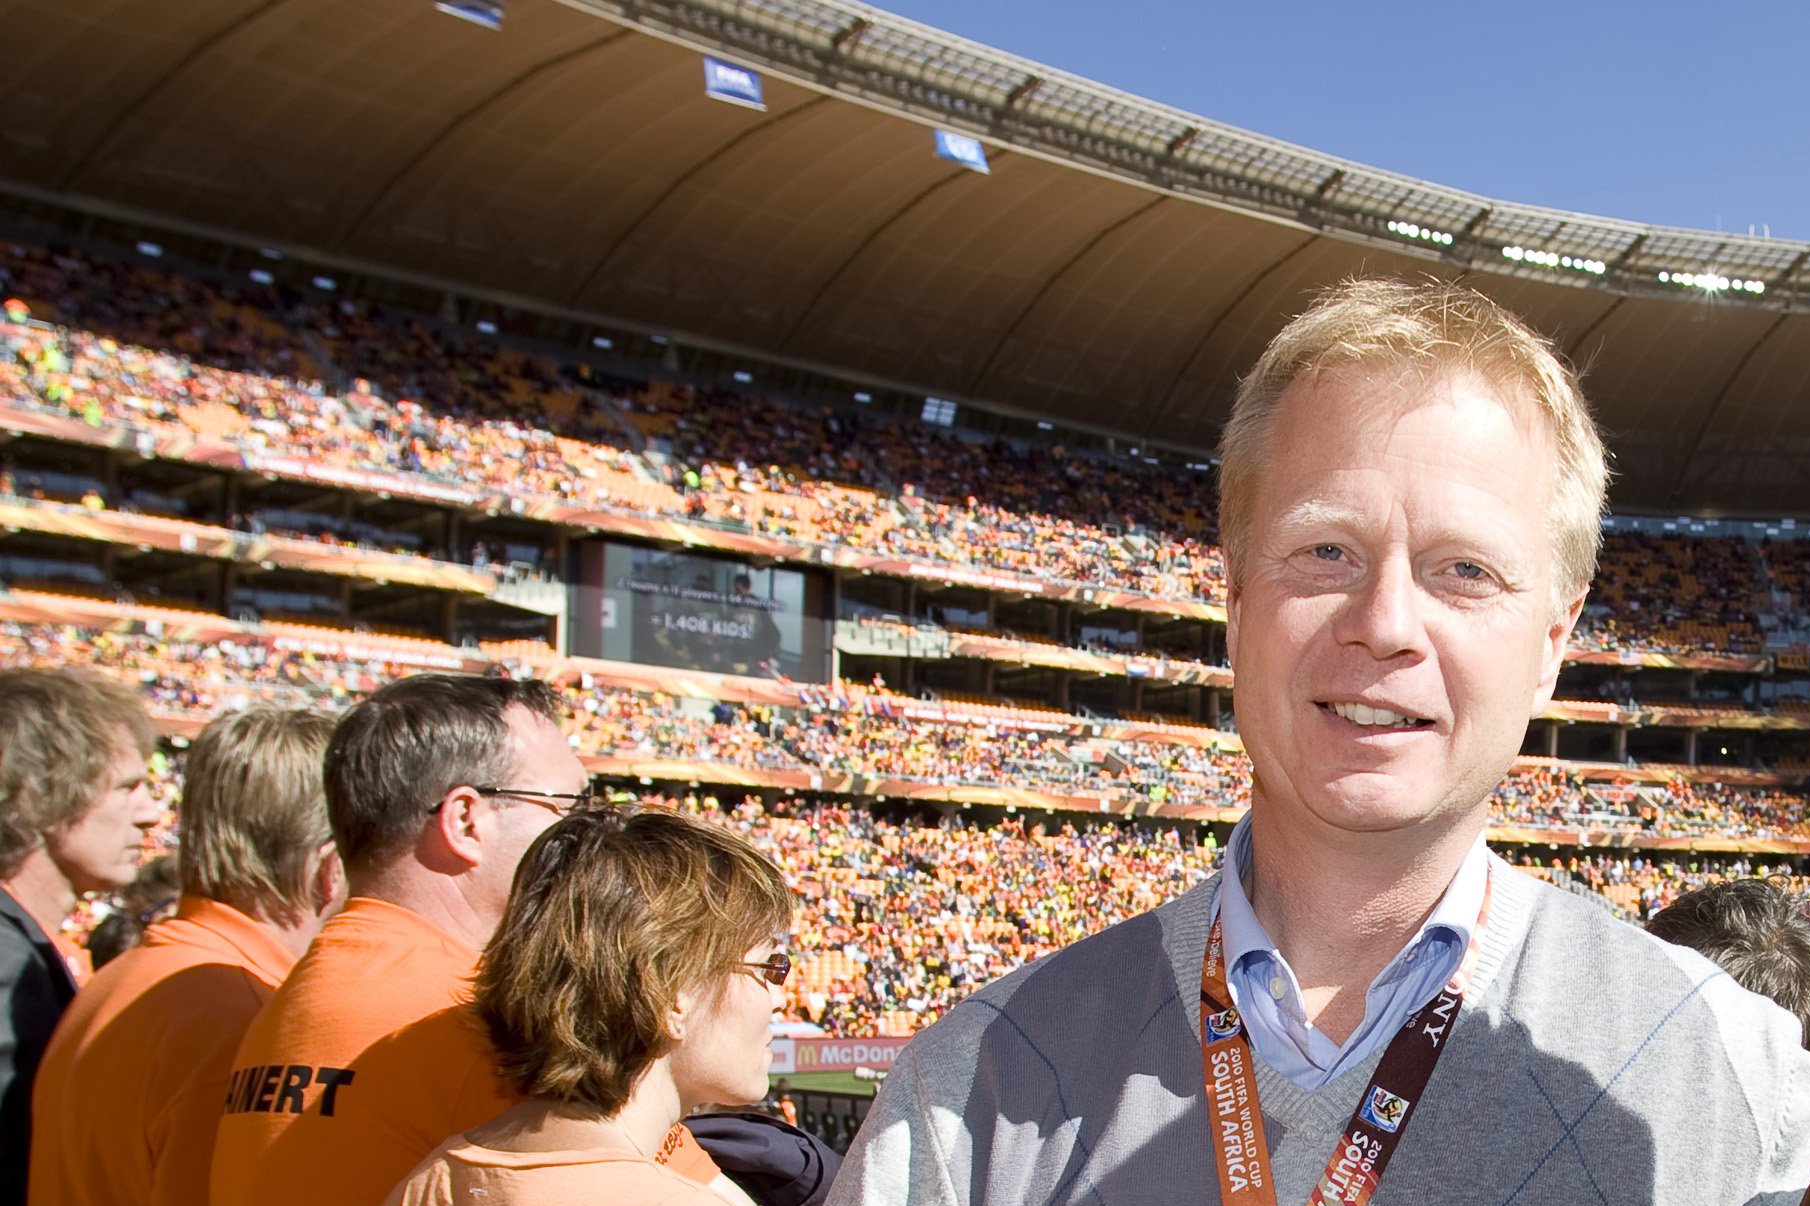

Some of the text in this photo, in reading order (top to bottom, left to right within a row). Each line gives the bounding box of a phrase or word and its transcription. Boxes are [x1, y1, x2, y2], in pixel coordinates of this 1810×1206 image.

[1211, 1051, 1248, 1193] SOUTH AFRICA
[1230, 1047, 1262, 1188] 2010 FIFA WORLD CUP
[1323, 1130, 1368, 1202] SOUTH
[1344, 1174, 1366, 1202] FIFA
[1360, 1140, 1382, 1172] 2010
